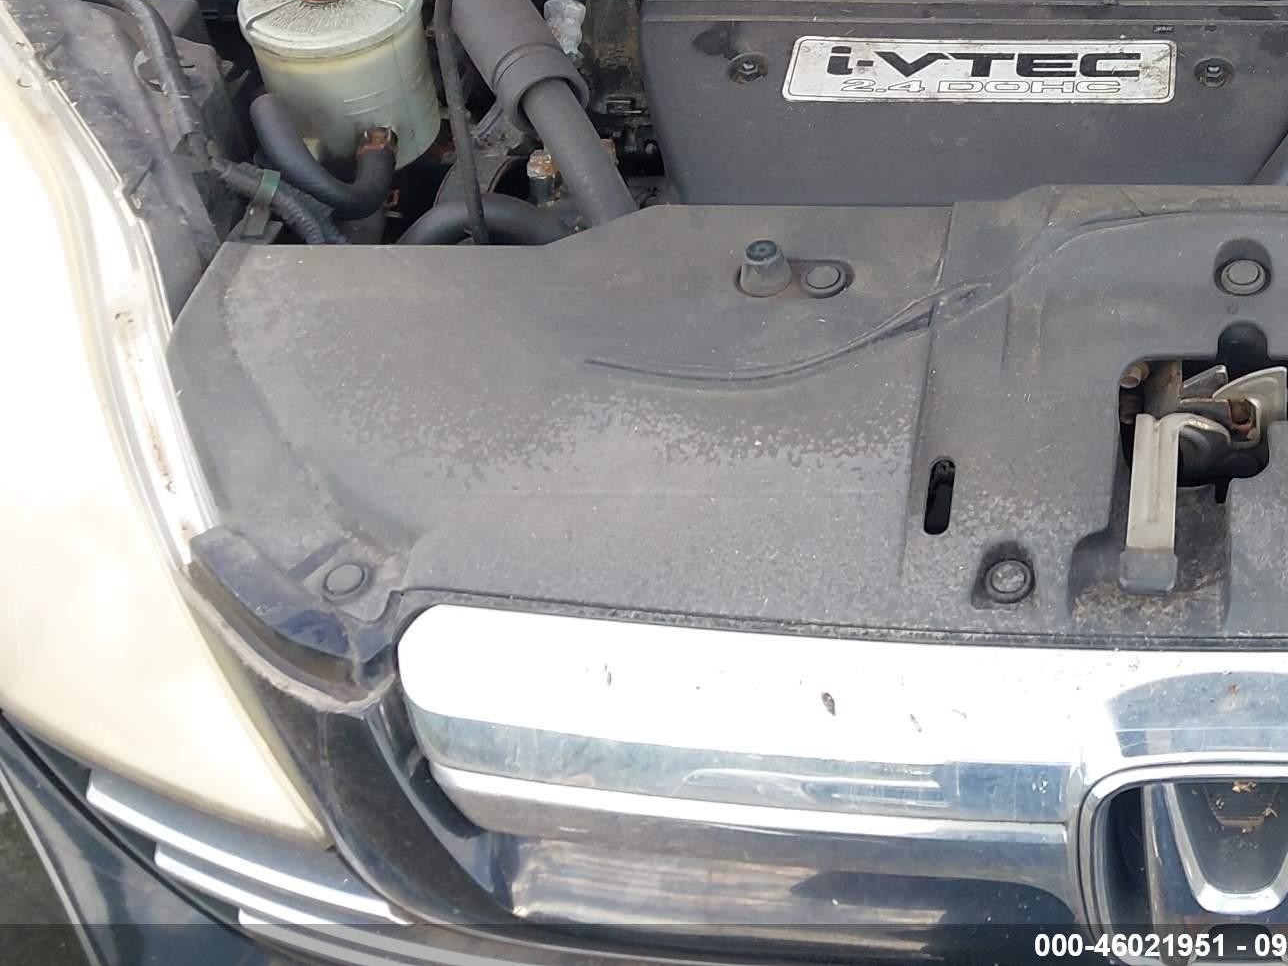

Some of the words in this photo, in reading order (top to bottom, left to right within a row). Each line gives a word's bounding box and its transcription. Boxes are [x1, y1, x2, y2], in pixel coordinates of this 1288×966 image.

[826, 45, 1141, 78] i-VTEC
[840, 78, 925, 93] 2.4
[937, 79, 1121, 94] DOHC
